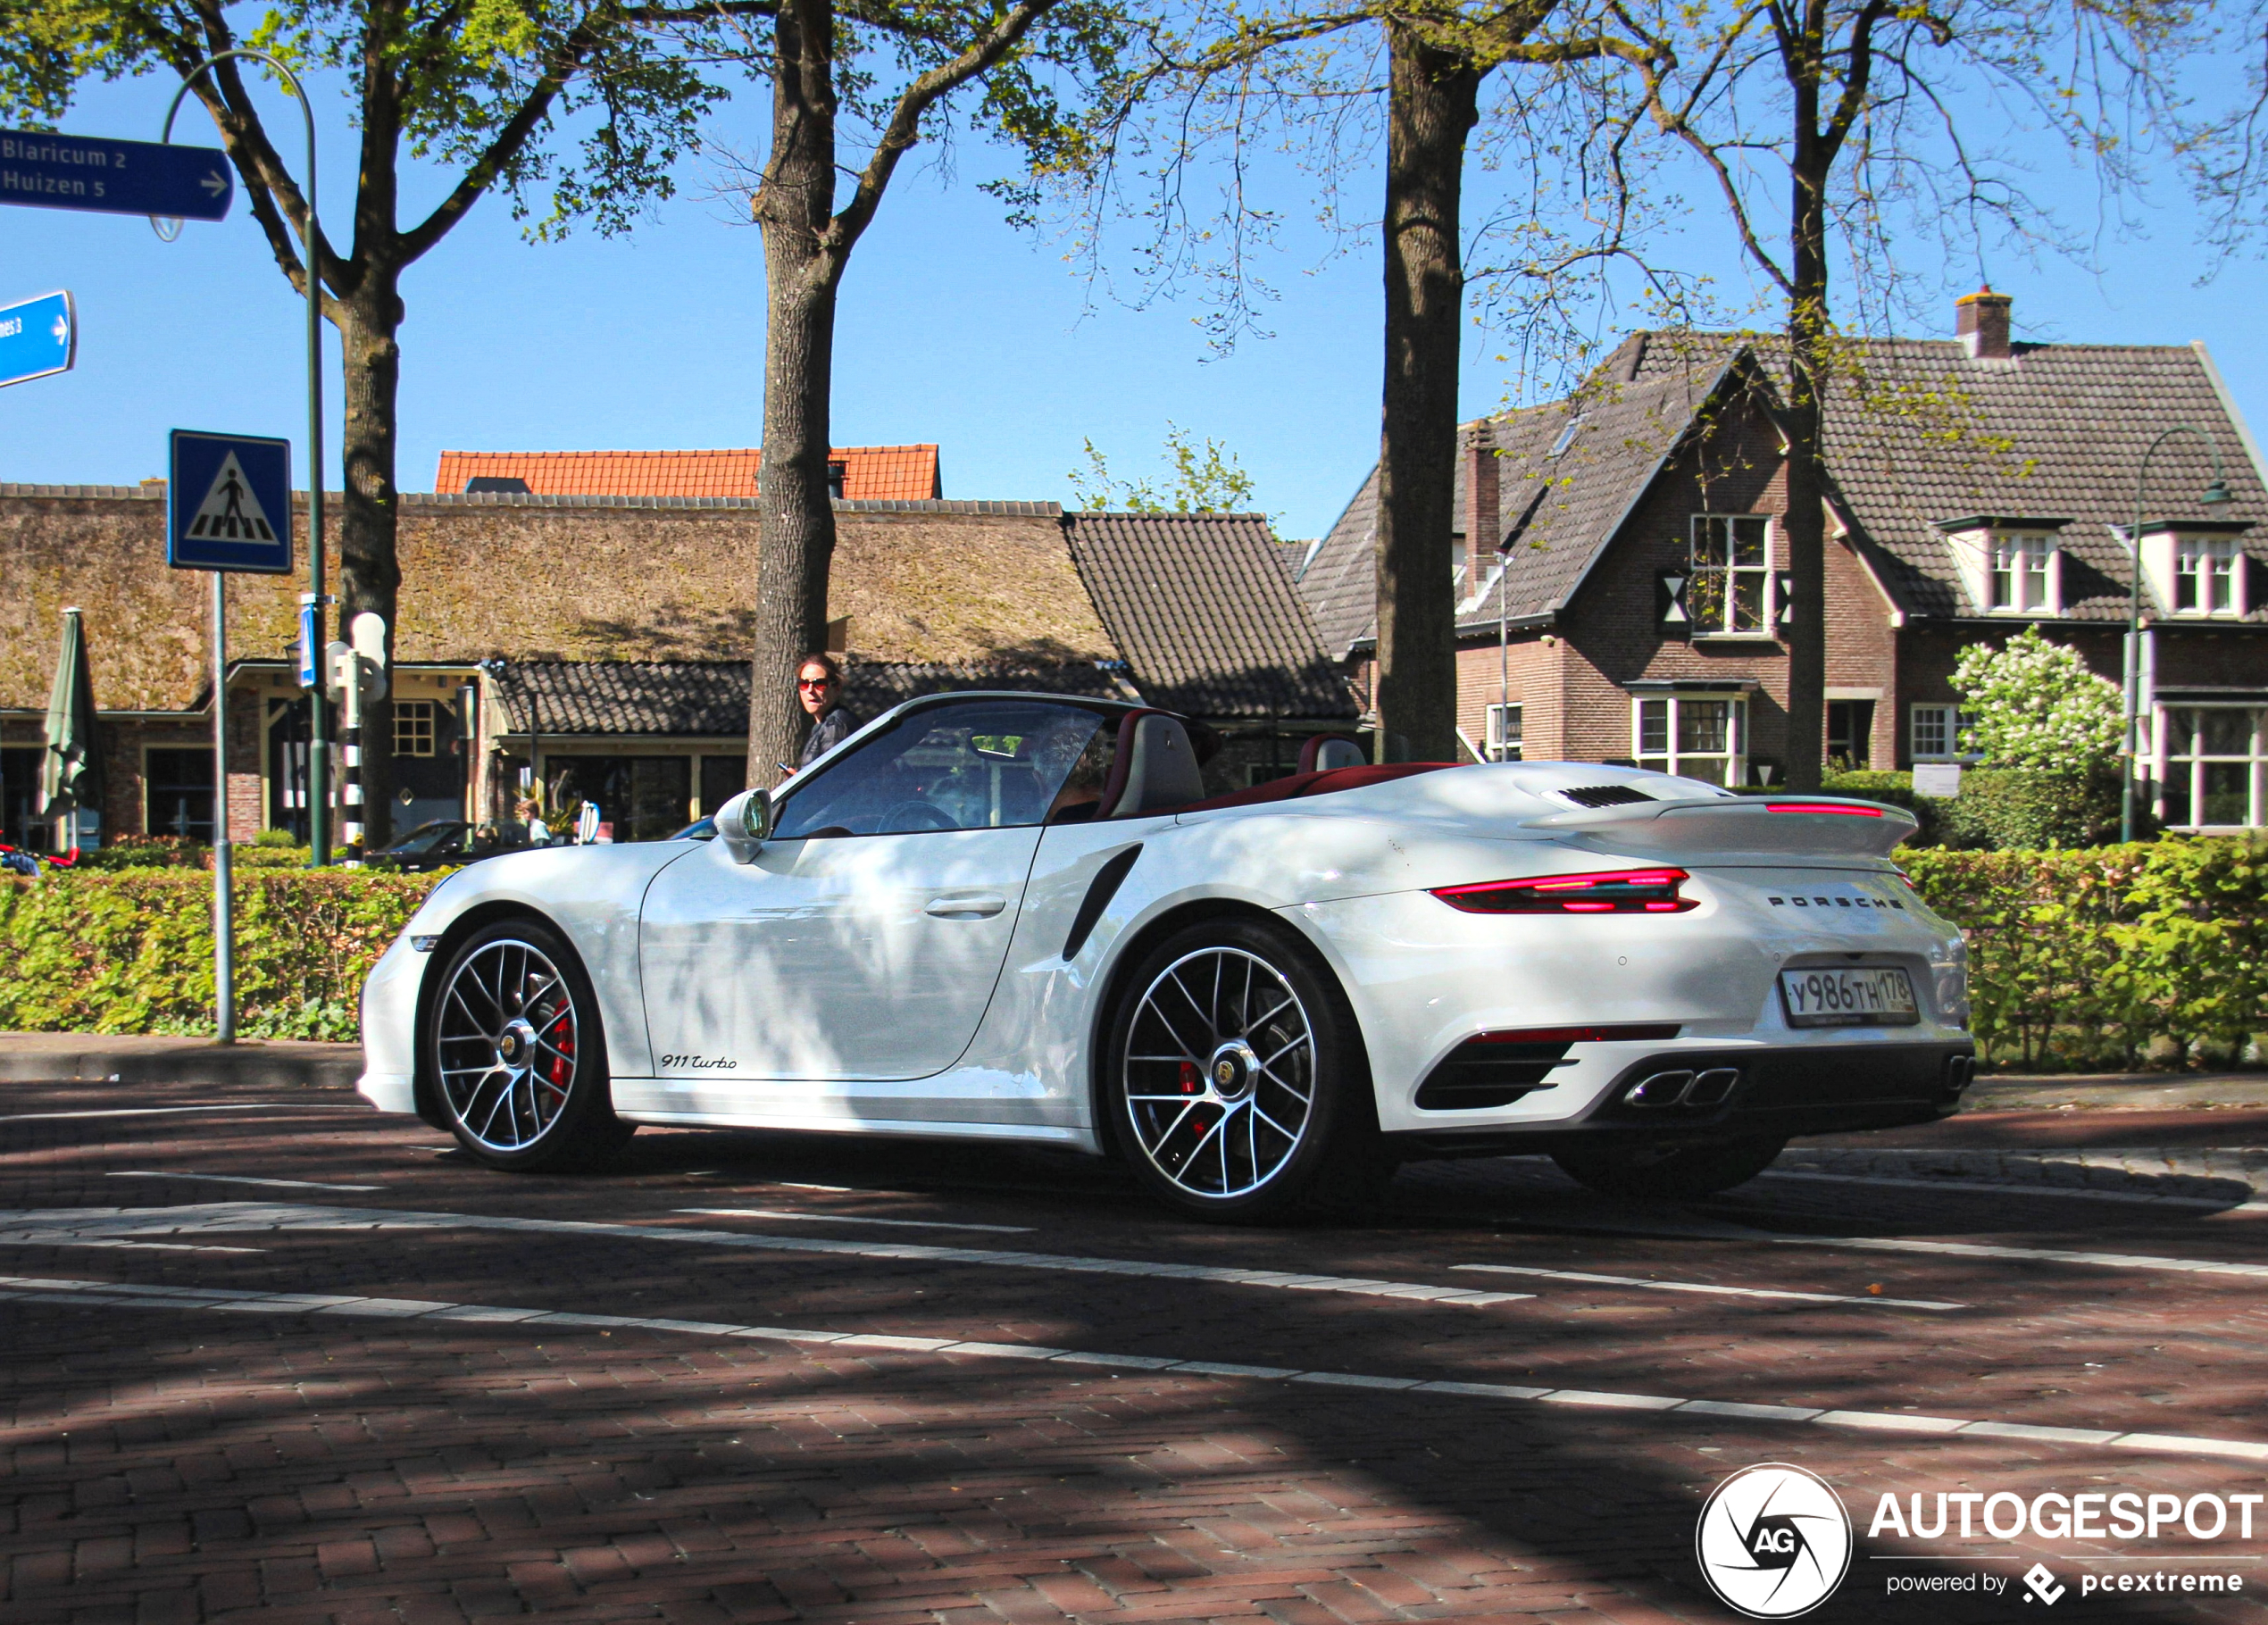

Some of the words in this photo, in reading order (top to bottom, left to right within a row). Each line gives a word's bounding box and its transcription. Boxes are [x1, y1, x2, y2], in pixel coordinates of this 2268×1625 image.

[2, 138, 106, 167] Blaricum
[114, 153, 127, 169] 2
[3, 171, 86, 196] Huizen
[94, 180, 105, 197] 5
[1767, 896, 1905, 910] PORSCHE
[1879, 971, 1909, 1000] 178
[662, 1054, 688, 1068] 911
